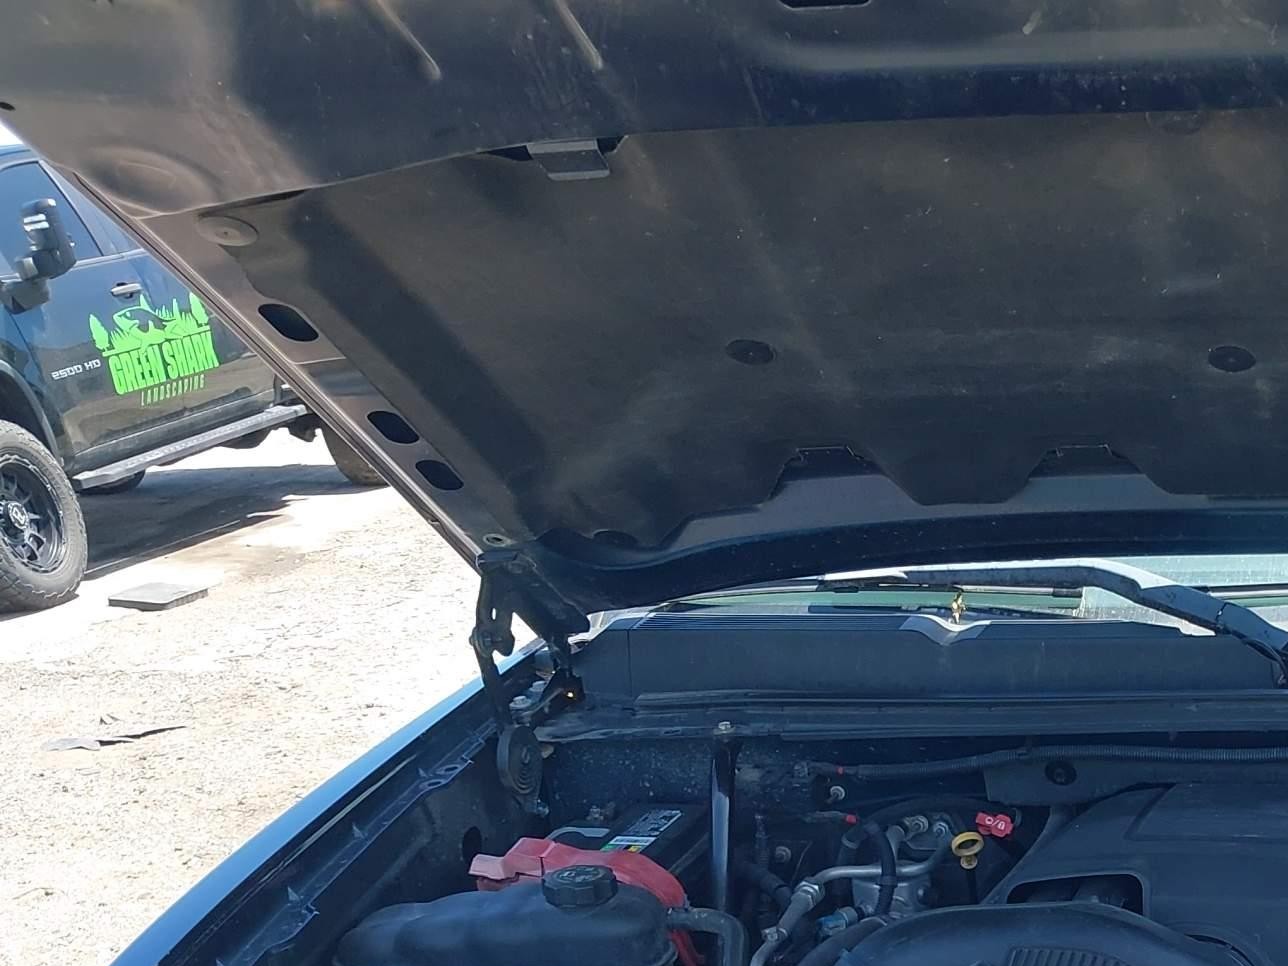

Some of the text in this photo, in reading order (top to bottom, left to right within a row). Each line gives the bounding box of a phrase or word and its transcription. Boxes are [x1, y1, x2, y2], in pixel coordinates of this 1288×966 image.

[51, 358, 102, 381] 2500 HD
[108, 331, 220, 396] GREEN SHARK
[140, 373, 206, 407] LANDSCAPING
